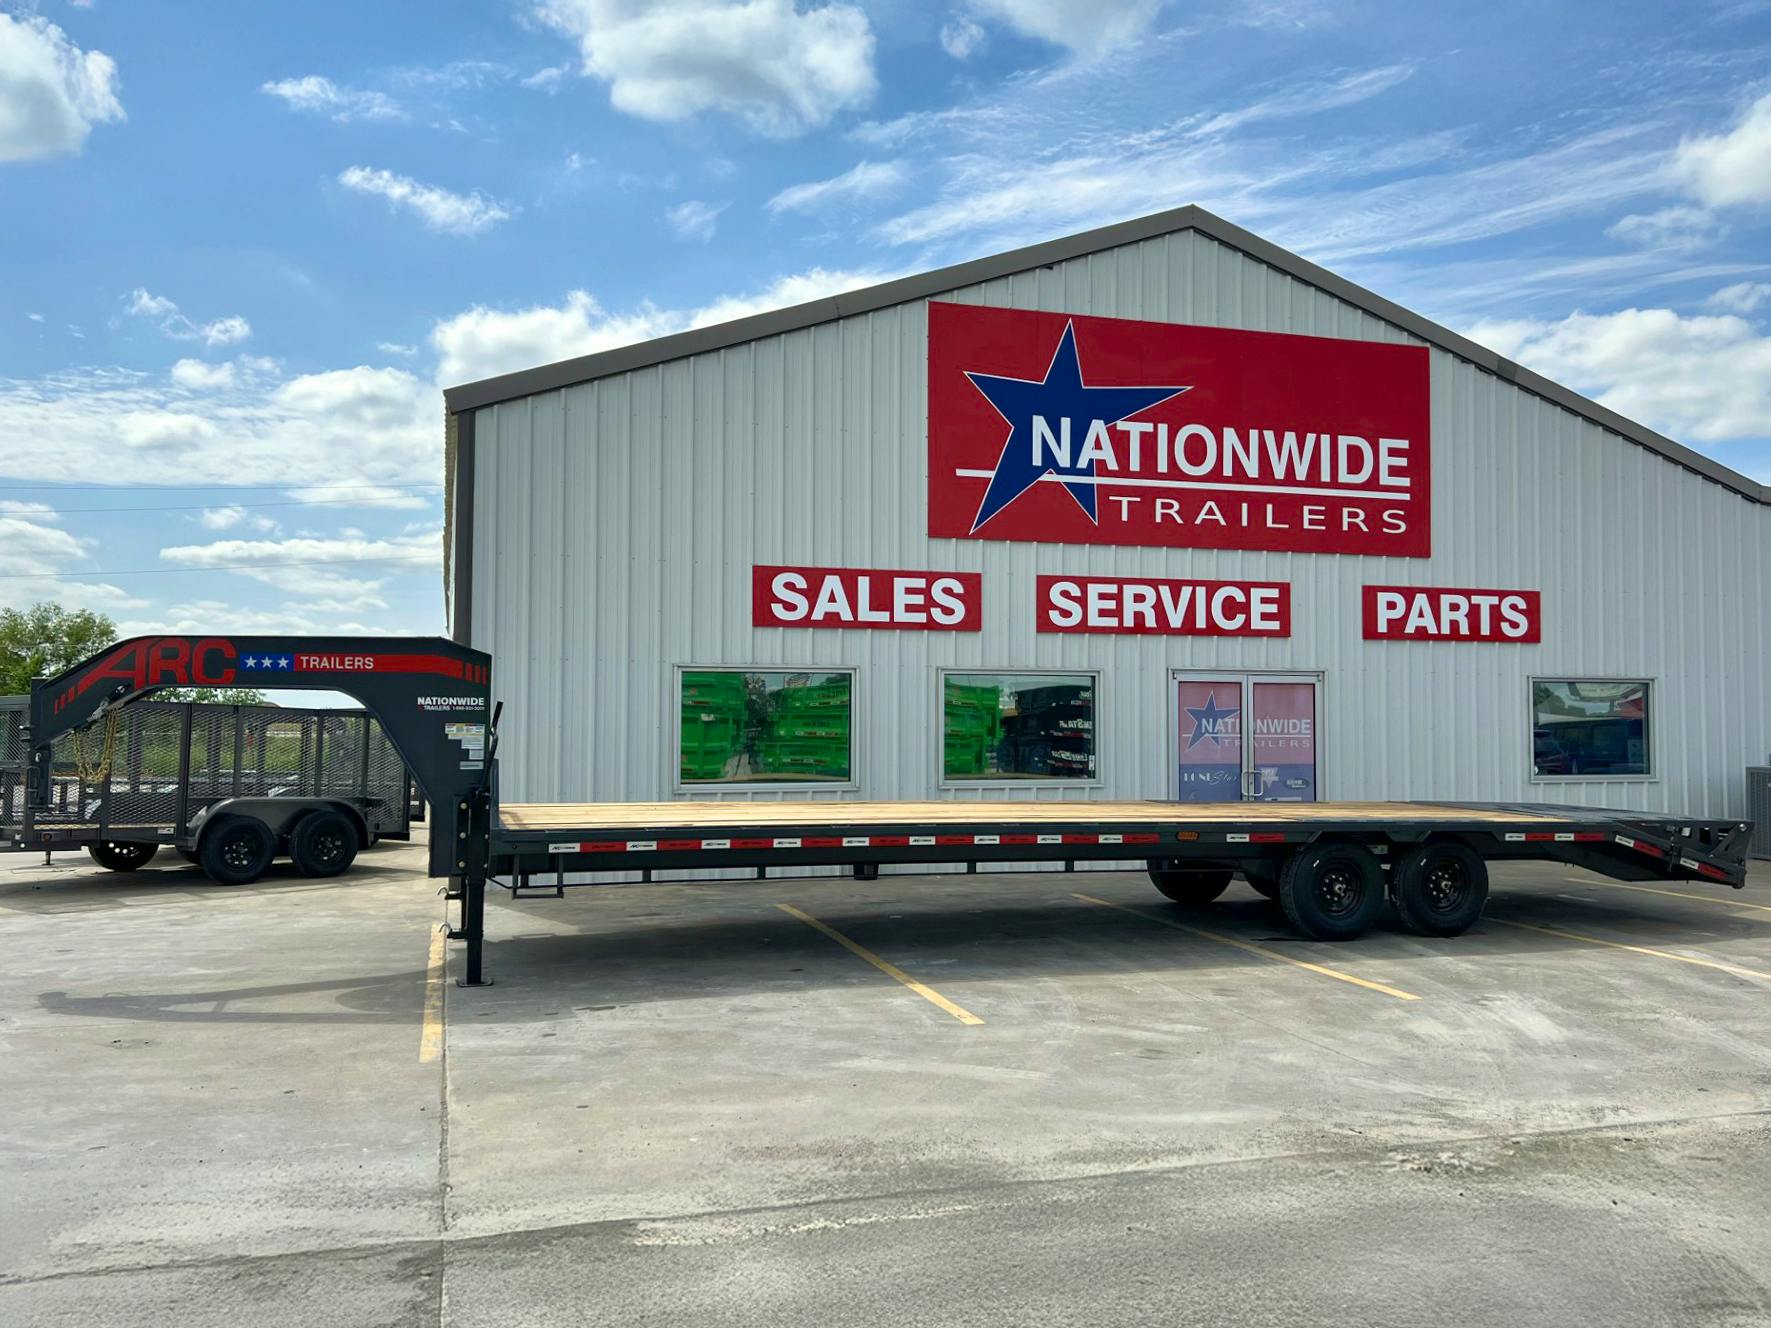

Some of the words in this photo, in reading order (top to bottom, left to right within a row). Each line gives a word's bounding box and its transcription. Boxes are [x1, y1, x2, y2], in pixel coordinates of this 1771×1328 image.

[1031, 414, 1411, 487] NATIONWIDE
[1109, 495, 1407, 534] TRAILERS
[769, 572, 967, 626] SALES
[1047, 581, 1282, 632] SERVICE
[1375, 590, 1530, 640] PARTS
[76, 636, 237, 691] ARC
[300, 655, 374, 671] TRAILERS
[417, 696, 485, 705] NATIONWIDE
[1201, 718, 1311, 734] NATINWIDE
